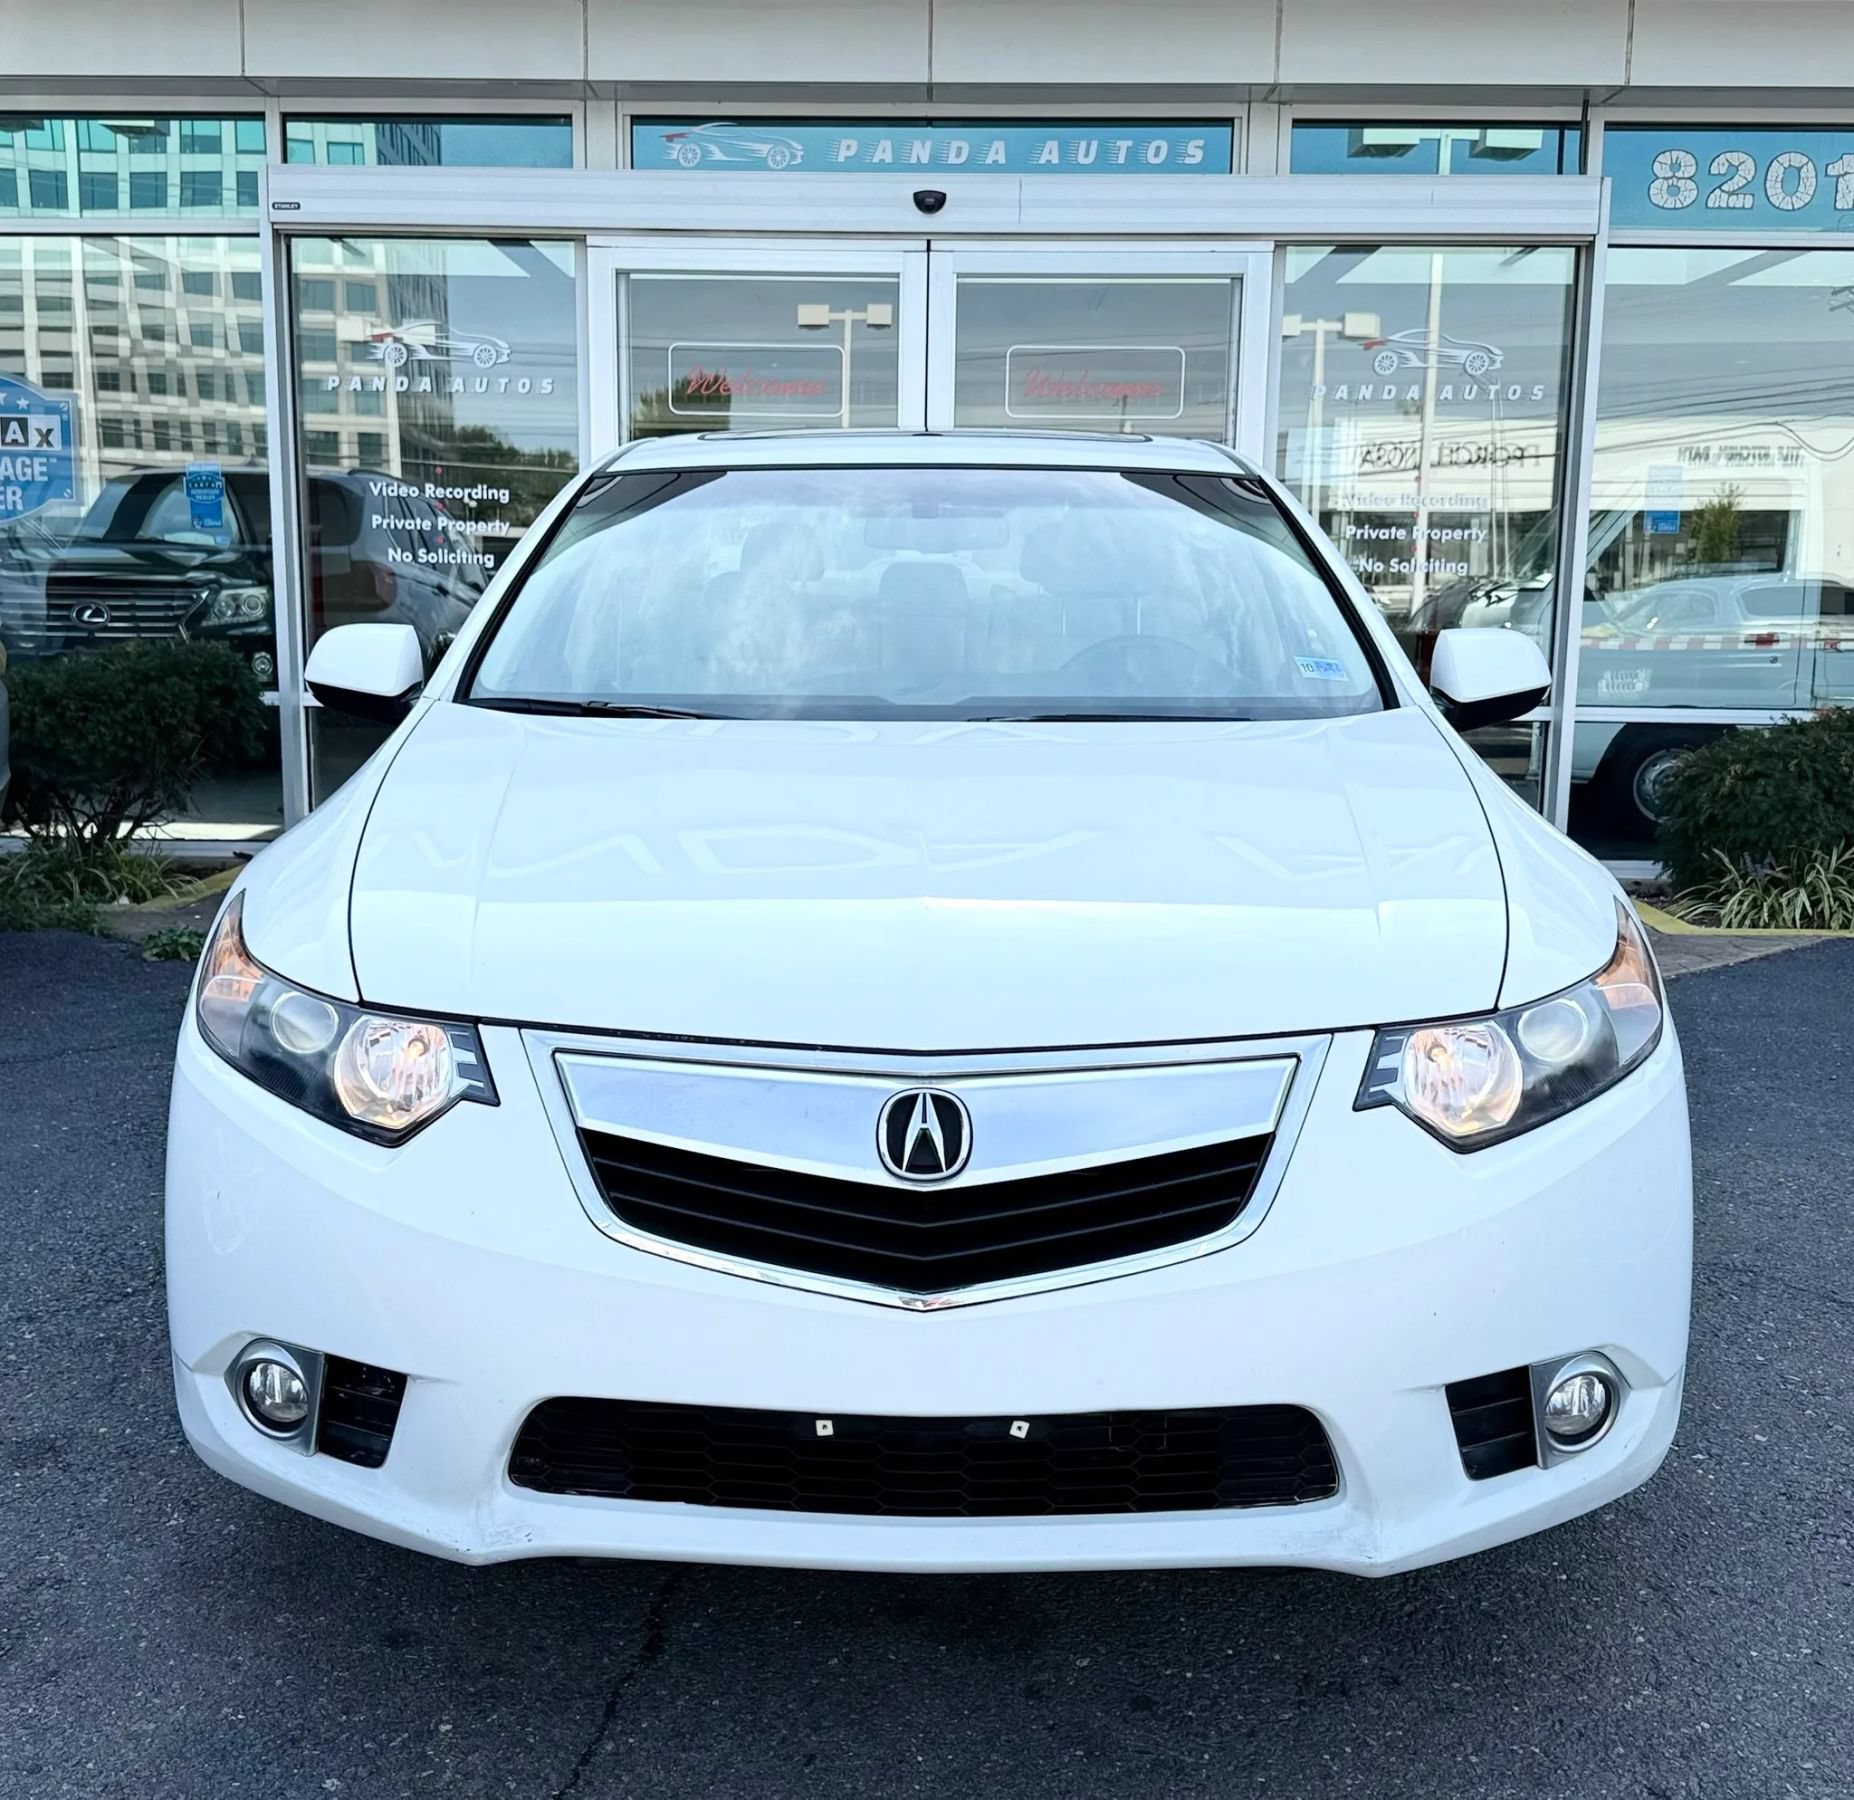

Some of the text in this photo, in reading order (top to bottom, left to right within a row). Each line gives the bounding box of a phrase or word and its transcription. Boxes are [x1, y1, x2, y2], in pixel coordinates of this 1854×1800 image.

[832, 139, 1204, 165] PANDA AUTOS
[1648, 149, 1854, 212] 8201
[326, 375, 554, 395] PANDA AUTOS
[1312, 383, 1545, 400] PANDA AUTOS
[369, 481, 510, 502] Video Recording
[371, 515, 510, 536] Private Property
[1345, 525, 1487, 543] Private Property
[388, 548, 495, 567] No Soliciting
[1359, 558, 1468, 575] No Soliciting
